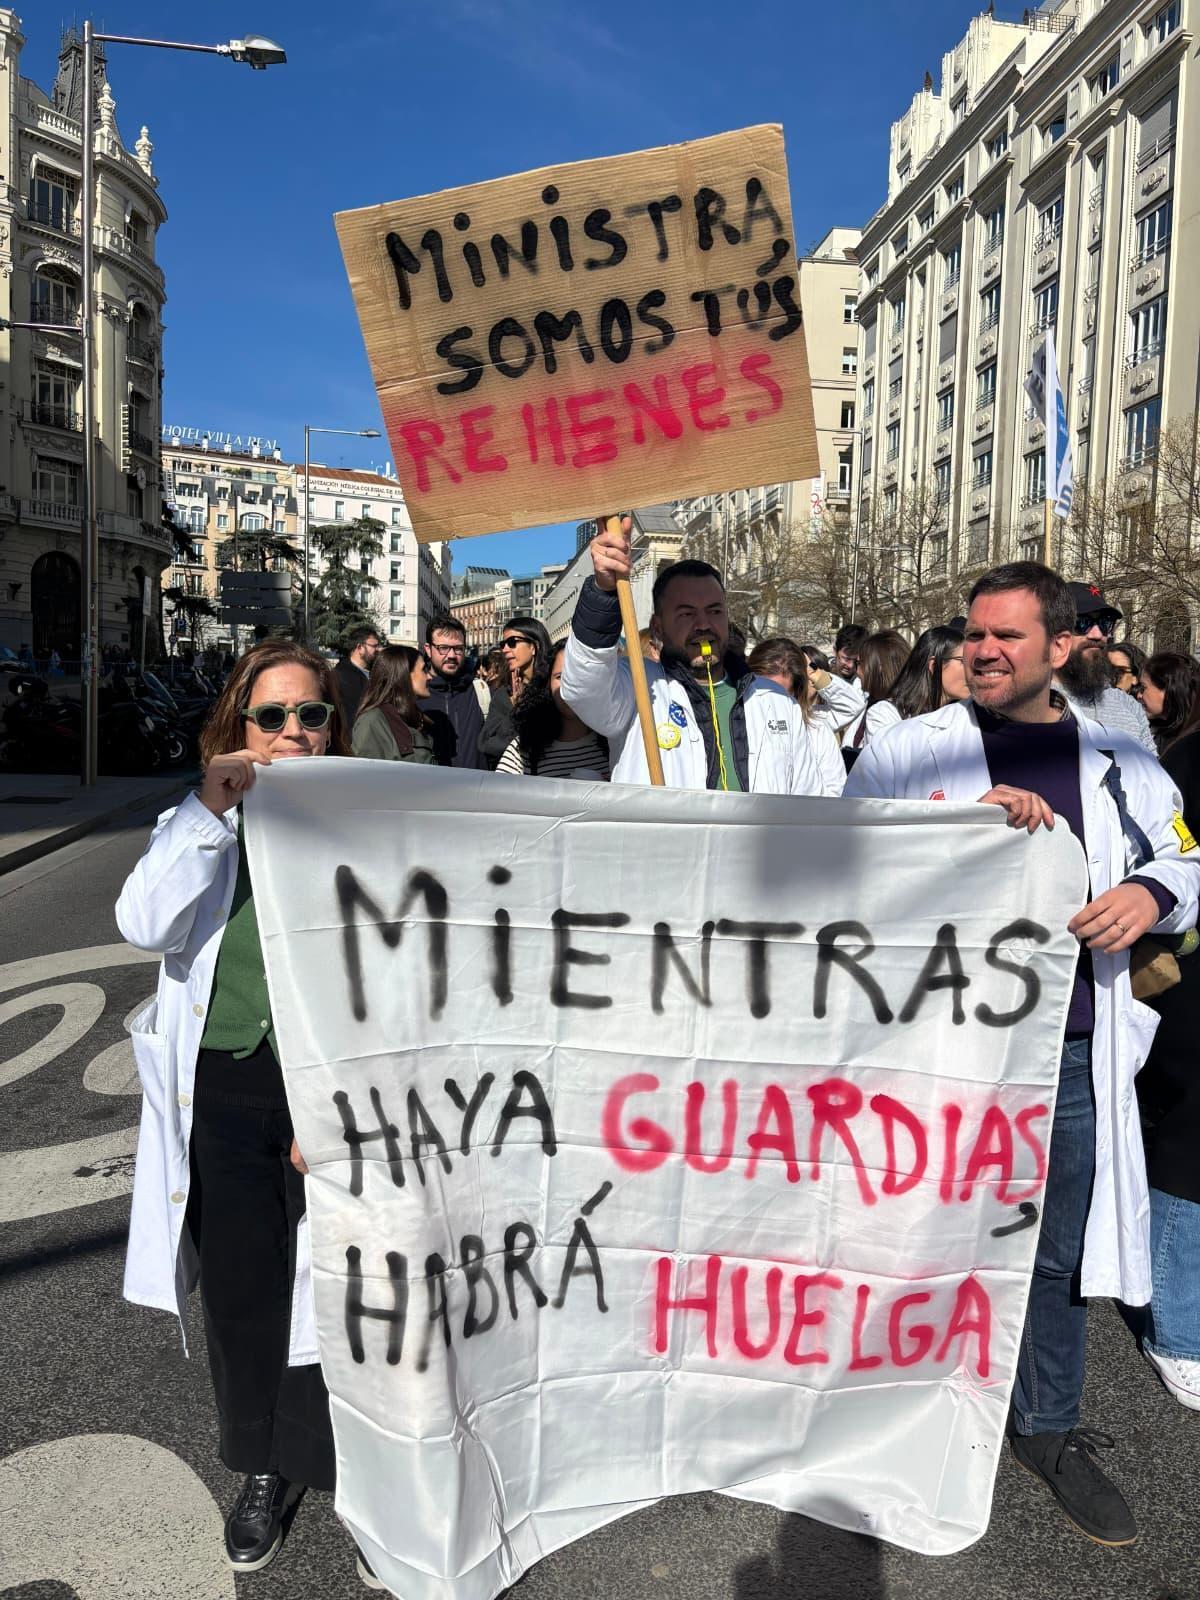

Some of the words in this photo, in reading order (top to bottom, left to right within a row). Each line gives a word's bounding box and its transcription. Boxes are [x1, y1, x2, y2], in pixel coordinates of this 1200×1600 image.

[436, 289, 677, 394] SOMOS
[162, 423, 199, 439] HOTEL
[206, 430, 242, 446] VILLA
[247, 436, 278, 450] REAL
[399, 353, 784, 492] REHENES
[300, 478, 339, 488] OGANIZACIÓN
[177, 618, 186, 630] P
[331, 1069, 558, 1196] HAYA
[344, 1180, 613, 1372] HABRÁ
[649, 1254, 992, 1377] HUELGA
